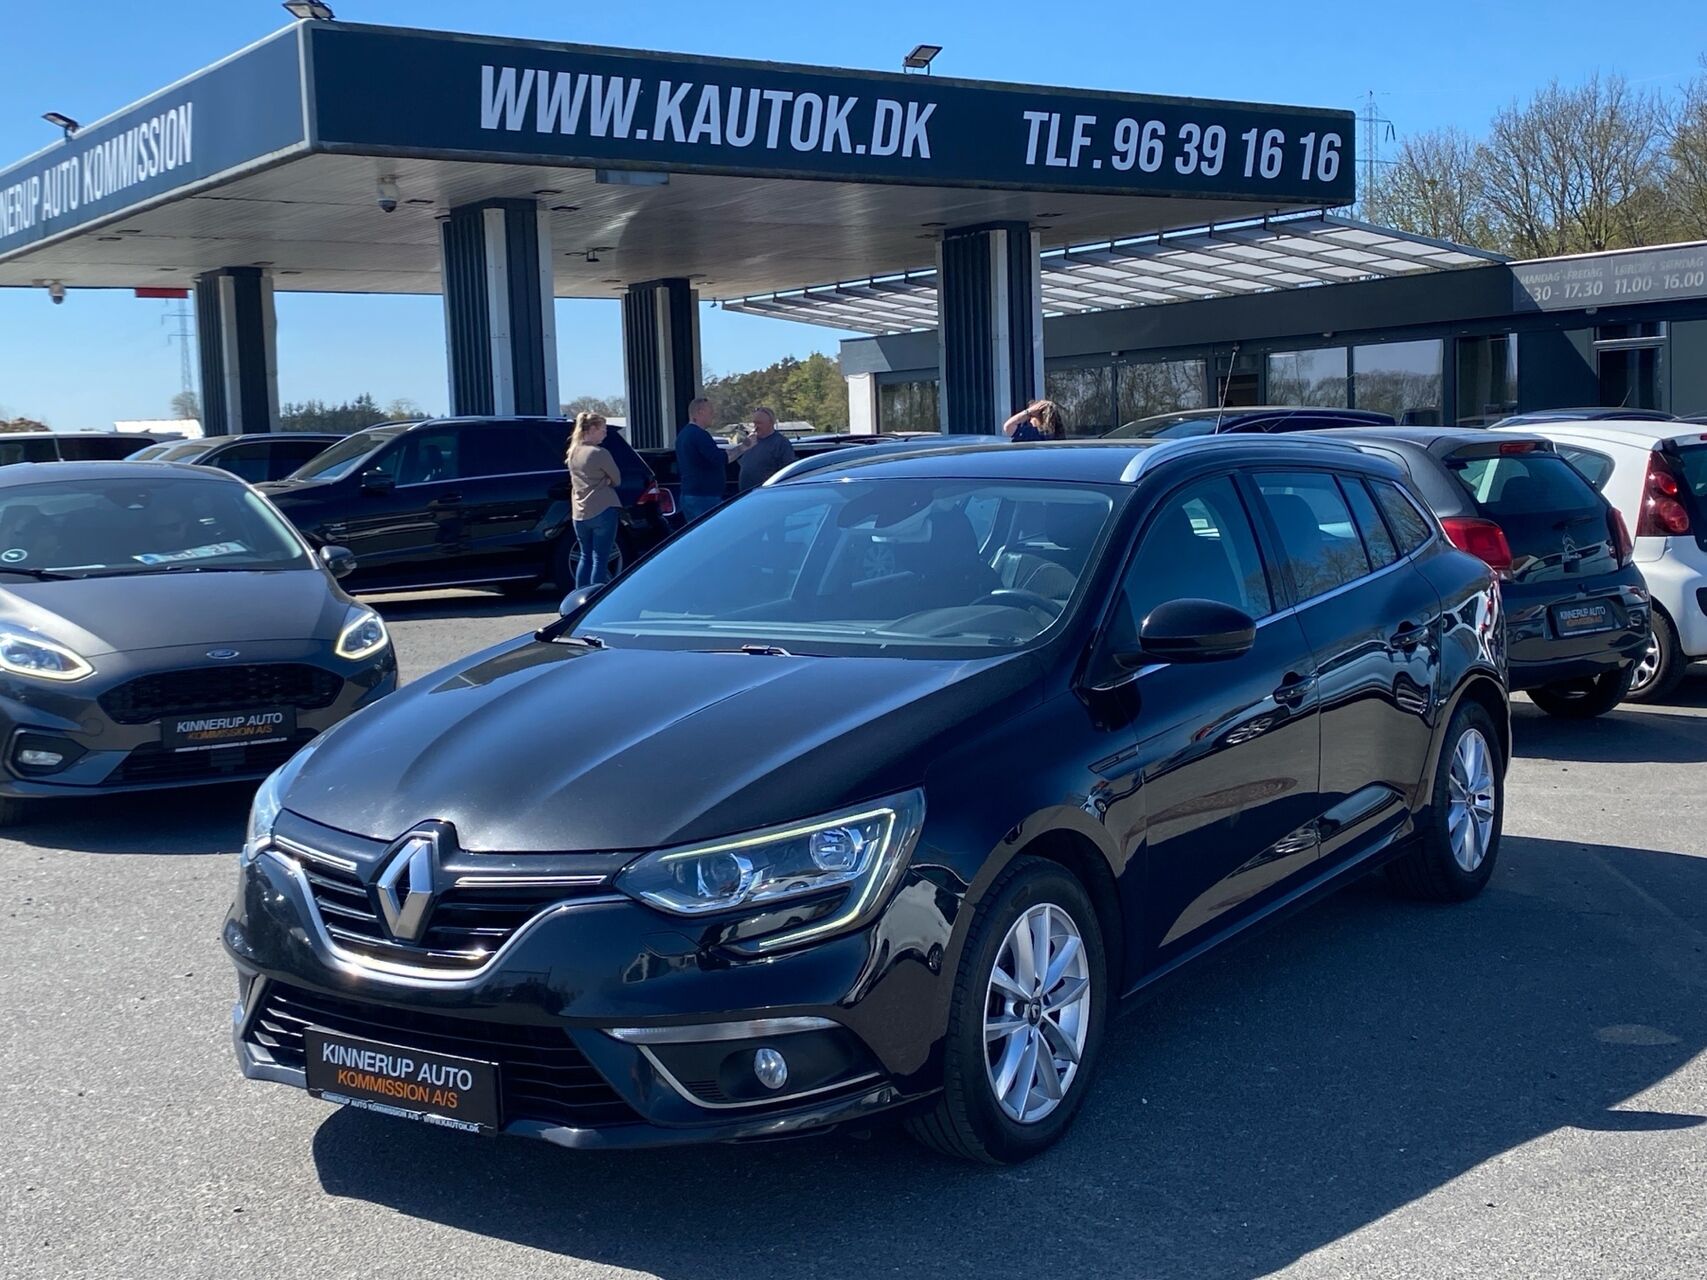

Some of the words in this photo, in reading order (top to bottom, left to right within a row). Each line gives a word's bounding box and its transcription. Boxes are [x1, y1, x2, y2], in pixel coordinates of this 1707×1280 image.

[480, 65, 937, 159] WWW.KAUTOK.DK
[41, 157, 79, 221] AUTO
[83, 102, 193, 205] KOMMISSION
[1023, 110, 1102, 169] TLF.
[1111, 117, 1166, 172] 96
[1175, 122, 1226, 176] 39
[1241, 127, 1285, 179] 16
[1299, 132, 1342, 182] 16
[1564, 280, 1603, 299] 17.30
[1614, 275, 1652, 294] 11.00
[1664, 271, 1704, 290] 16.00
[177, 716, 245, 733] KINNERUP
[247, 712, 283, 726] AUTO
[322, 1042, 414, 1079] KINNERUP
[417, 1062, 473, 1091] AUTO
[337, 1069, 429, 1104] KOMMISSION
[431, 1090, 458, 1109] A/S
